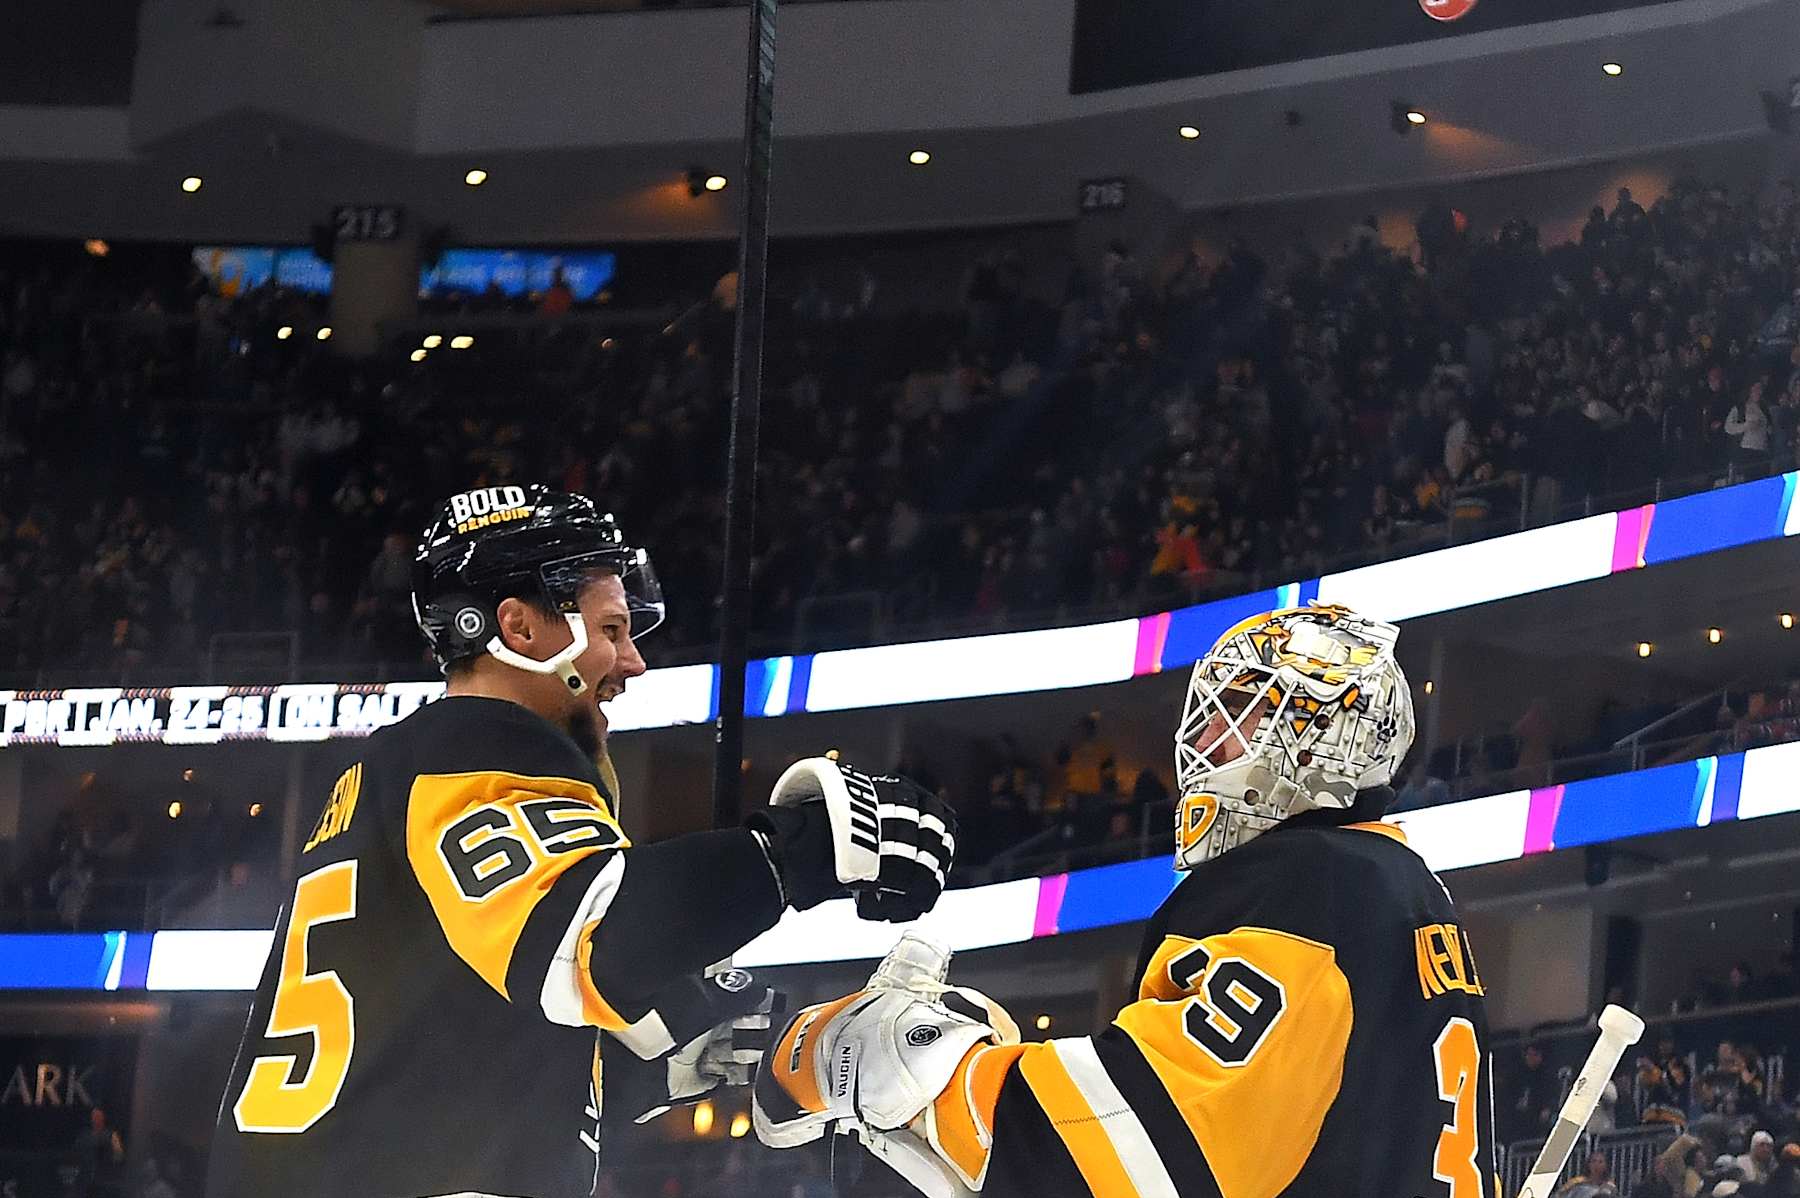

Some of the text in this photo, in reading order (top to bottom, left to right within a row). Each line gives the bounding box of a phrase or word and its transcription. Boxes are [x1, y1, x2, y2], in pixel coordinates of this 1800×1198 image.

[451, 486, 526, 524] BOLD
[436, 796, 632, 903] 65
[836, 1045, 852, 1098] VAUGHN
